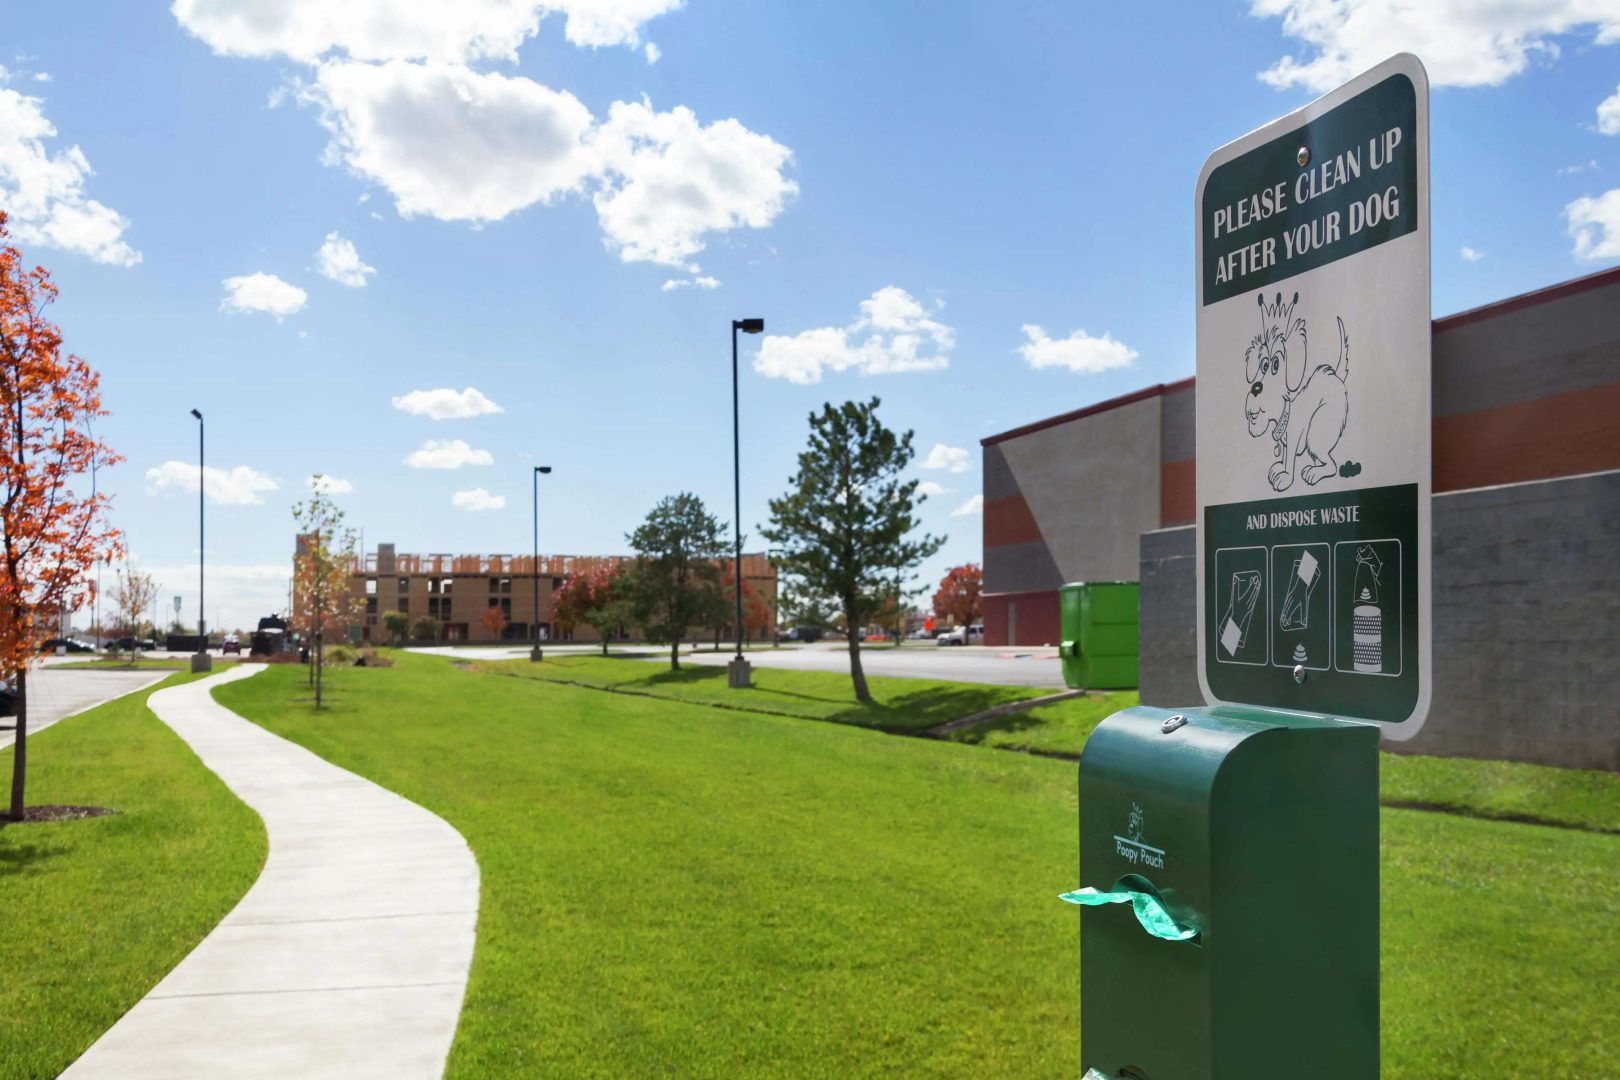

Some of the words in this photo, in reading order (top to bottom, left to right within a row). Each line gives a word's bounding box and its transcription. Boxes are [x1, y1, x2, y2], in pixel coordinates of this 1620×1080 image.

[1214, 181, 1287, 239] PLEASE
[1295, 145, 1361, 204] CLEAN
[1369, 127, 1402, 170] UP
[1215, 237, 1276, 285] AFTER
[1283, 211, 1341, 260] YOUR
[1349, 185, 1400, 235] DOG
[1246, 515, 1268, 531] AND
[1270, 509, 1317, 530] DISPOSE
[1320, 505, 1360, 523] WASTE
[1116, 840, 1138, 864] Poopy
[1140, 848, 1164, 870] Pouch
